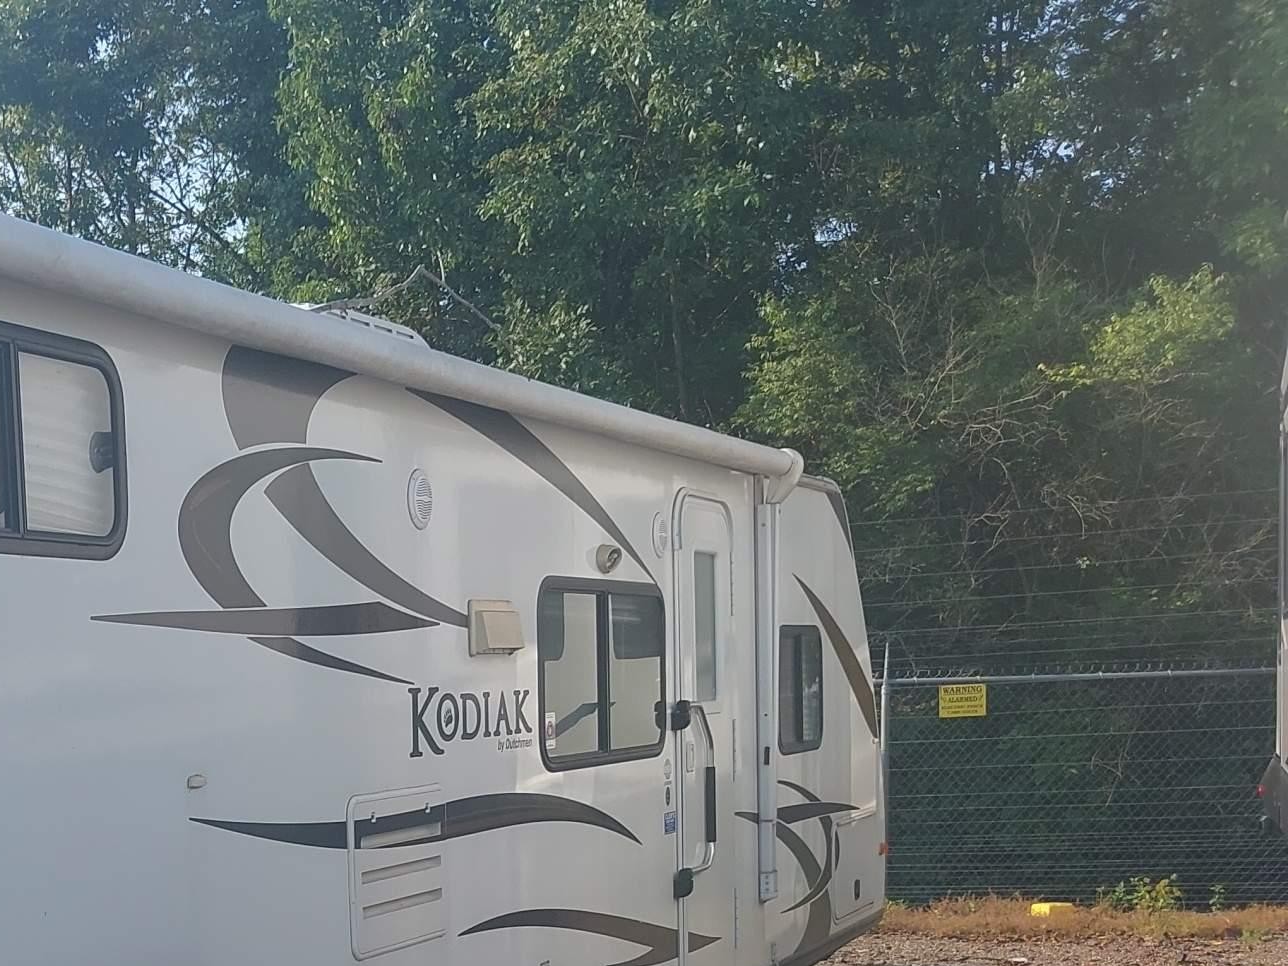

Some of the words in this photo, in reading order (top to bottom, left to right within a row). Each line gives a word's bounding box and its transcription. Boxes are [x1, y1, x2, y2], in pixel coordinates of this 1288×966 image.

[943, 686, 982, 695] WARNING
[408, 687, 532, 757] KODIAK
[498, 739, 504, 752] by
